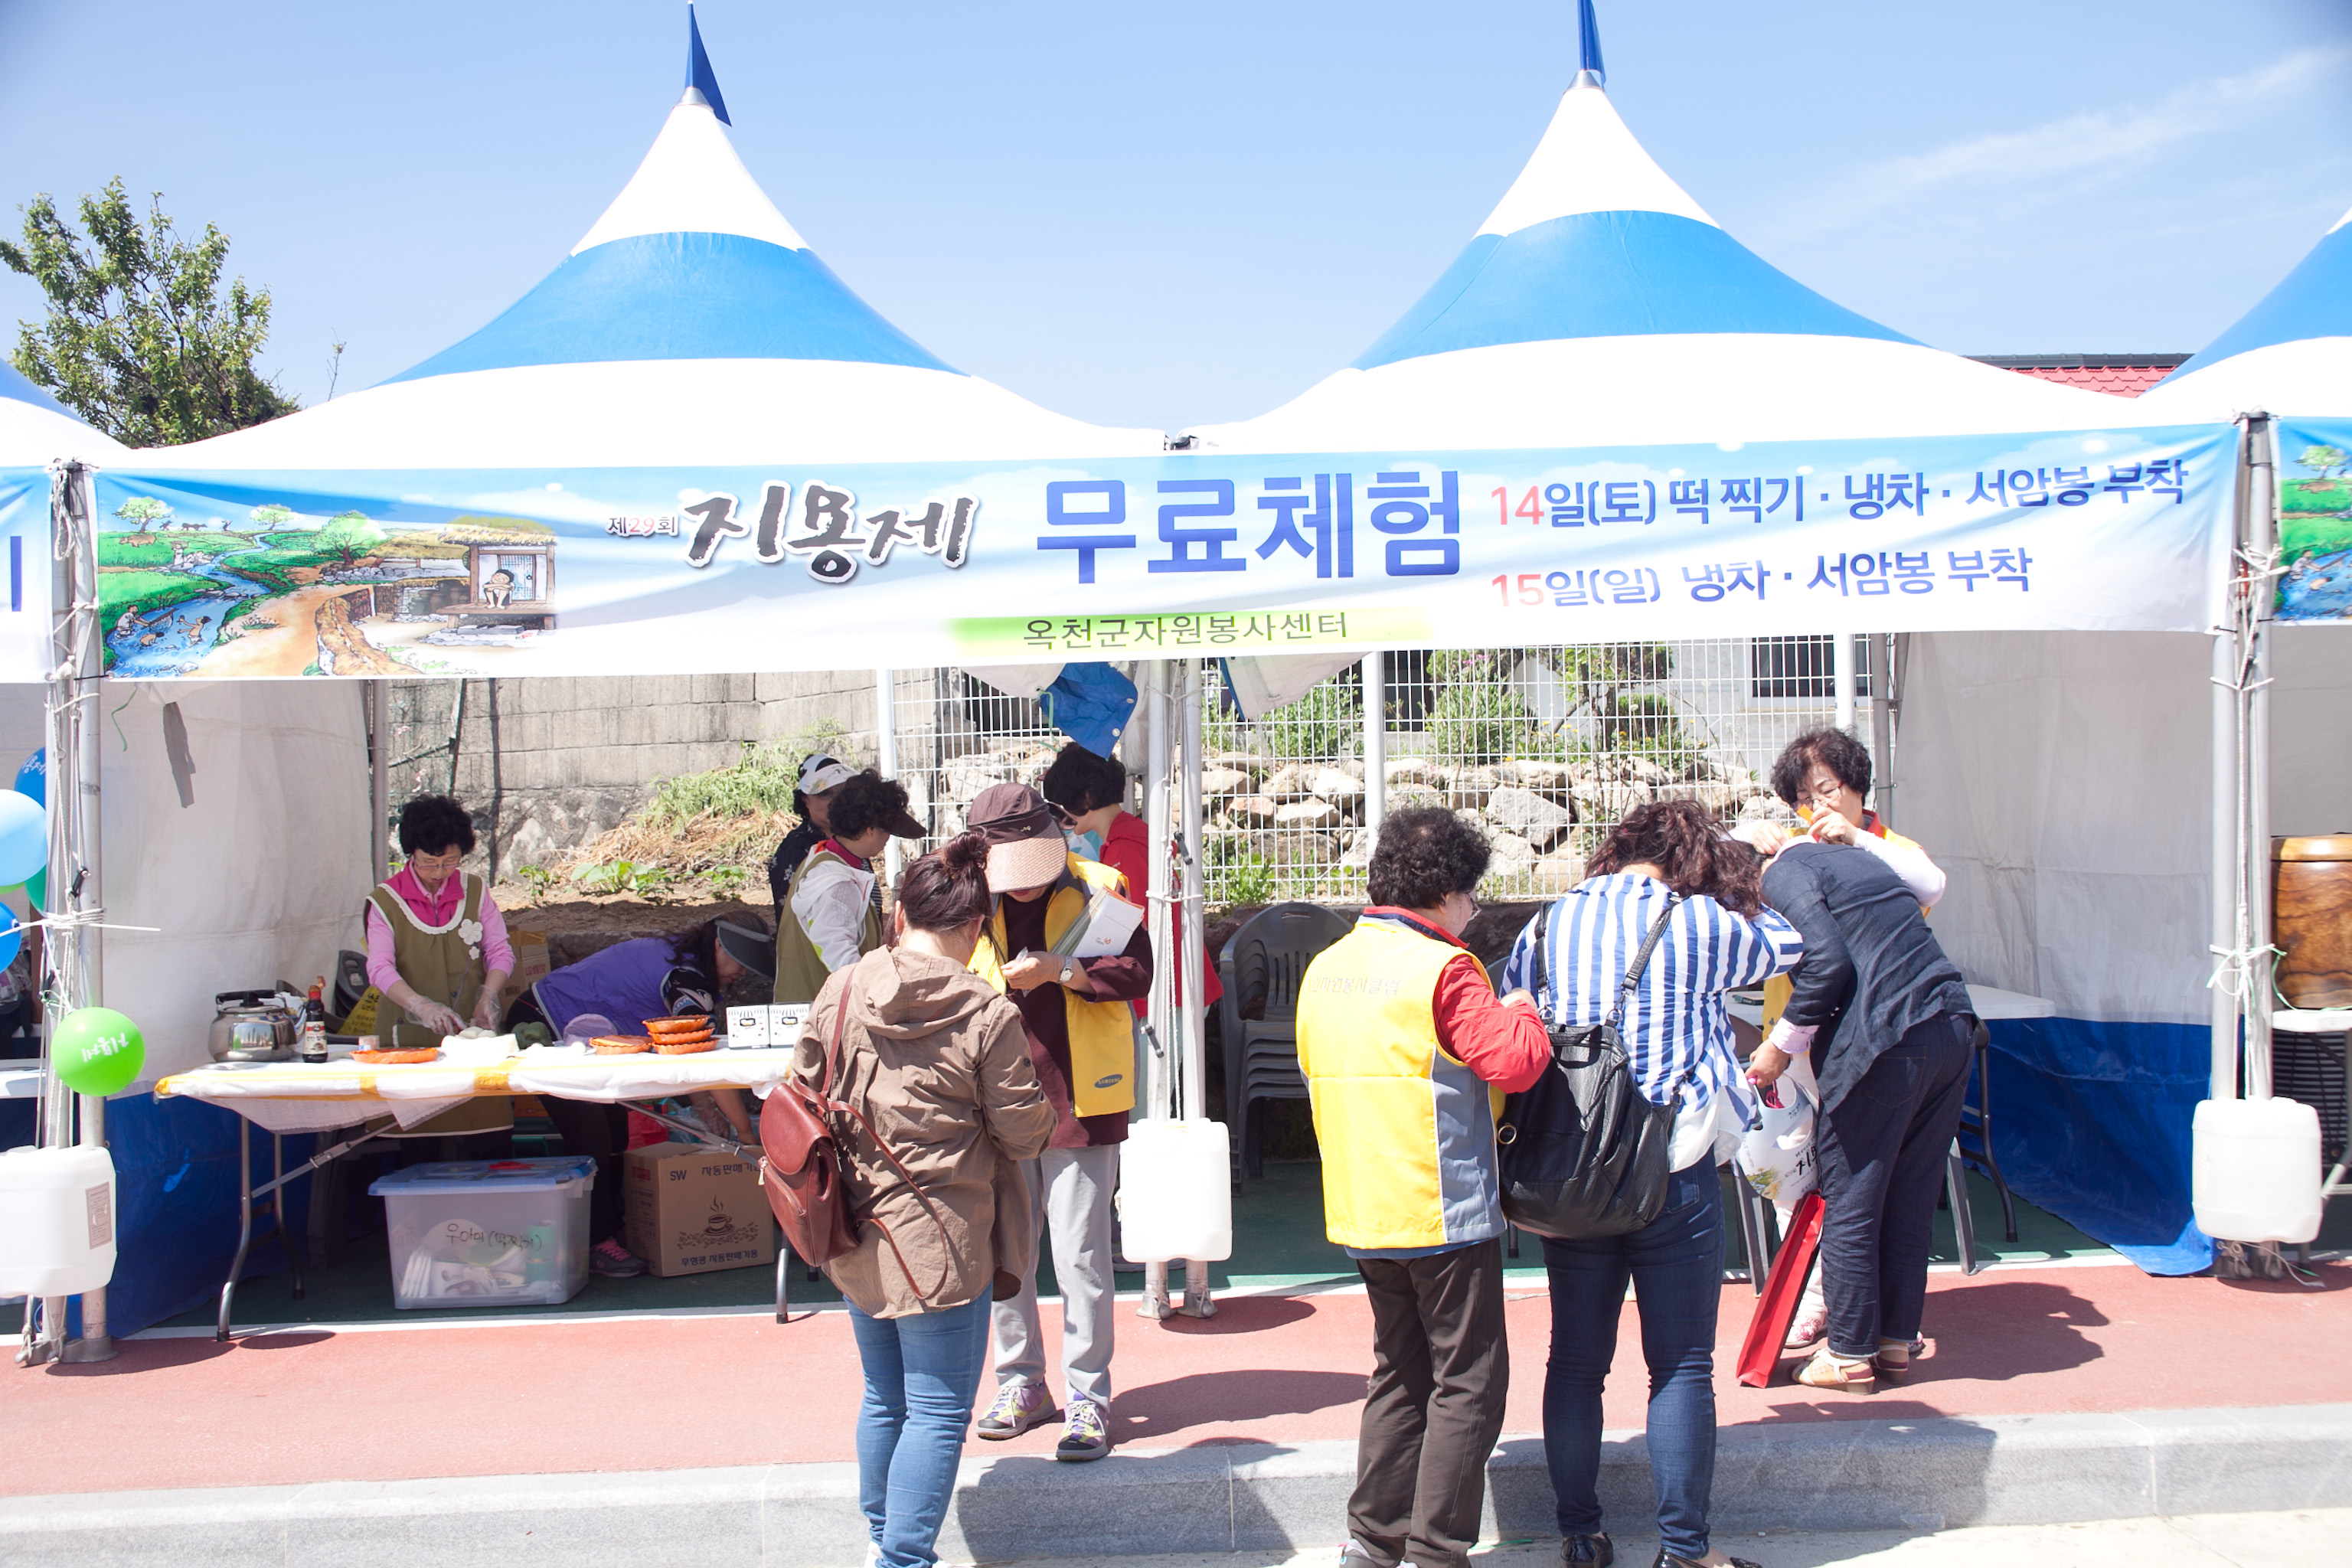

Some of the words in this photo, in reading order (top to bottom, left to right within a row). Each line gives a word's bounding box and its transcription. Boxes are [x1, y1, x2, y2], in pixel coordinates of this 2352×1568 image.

[1491, 480, 1656, 528] 14일(토)
[1669, 479, 1709, 524] 떡
[1720, 475, 1804, 524] 찍기
[1845, 472, 1929, 520] 냉차
[1965, 466, 2095, 508] 서암봉
[2103, 459, 2189, 505] 부착
[607, 514, 678, 536] 제29회
[684, 485, 974, 578] 지용제
[1037, 471, 1460, 584] 무료체험
[1491, 567, 1661, 607] 15일(일)
[1681, 560, 1770, 602] 냉차
[1807, 552, 1935, 596] 서암봉
[1948, 547, 2033, 592] 부착
[1023, 612, 1347, 650] 옥천군자원봉사센터
[22, 754, 46, 776] 용제
[670, 1170, 687, 1181] SW
[709, 1249, 758, 1263] 자동판매기용
